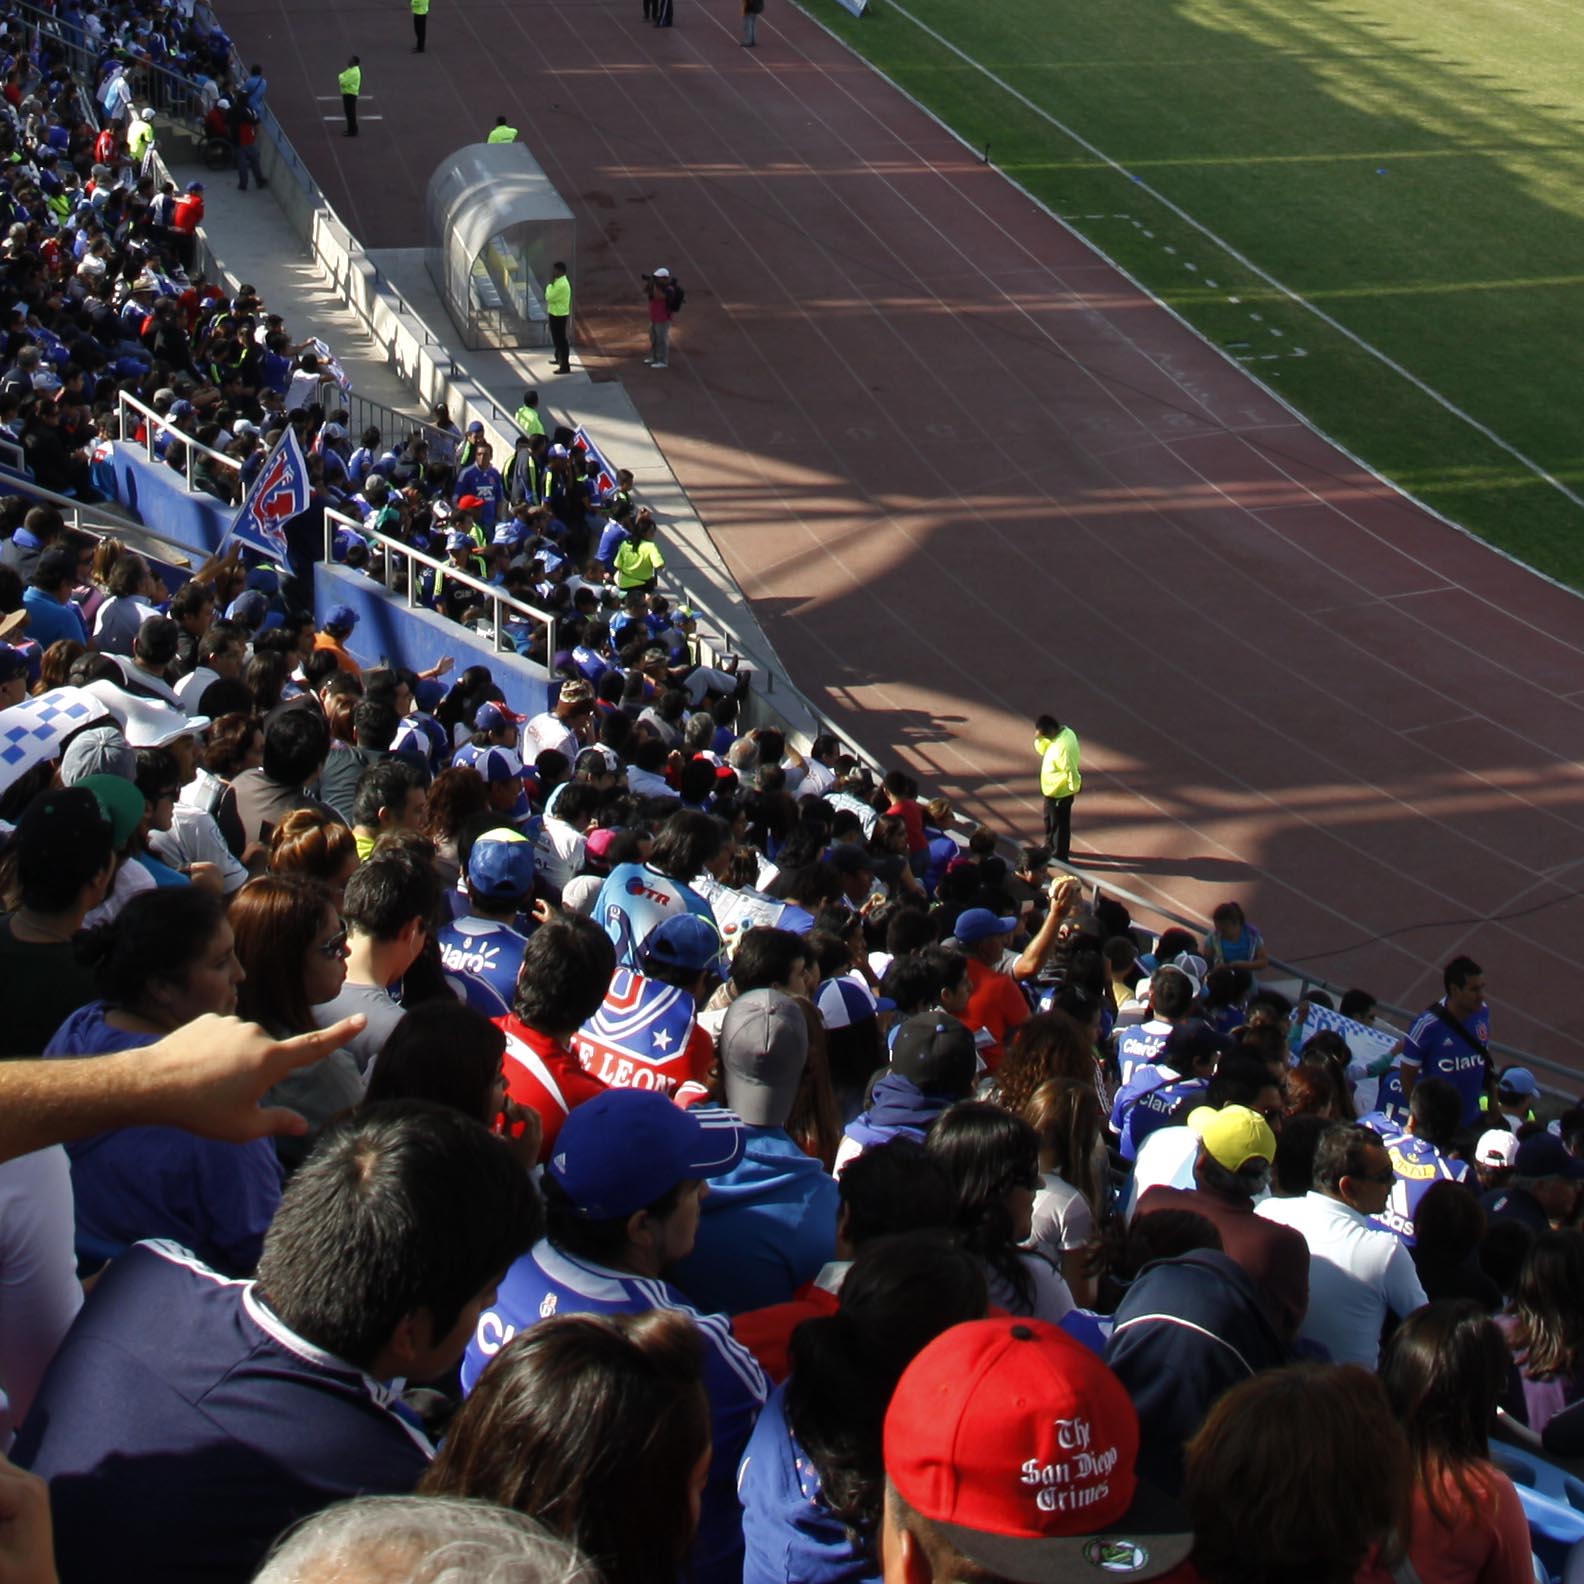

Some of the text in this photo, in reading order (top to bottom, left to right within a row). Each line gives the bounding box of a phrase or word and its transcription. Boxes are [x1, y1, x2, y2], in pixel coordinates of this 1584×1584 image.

[438, 941, 484, 974] laro
[1055, 1418, 1090, 1450] The
[1021, 1446, 1118, 1485] San Diego
[1036, 1482, 1109, 1511] Crimes
